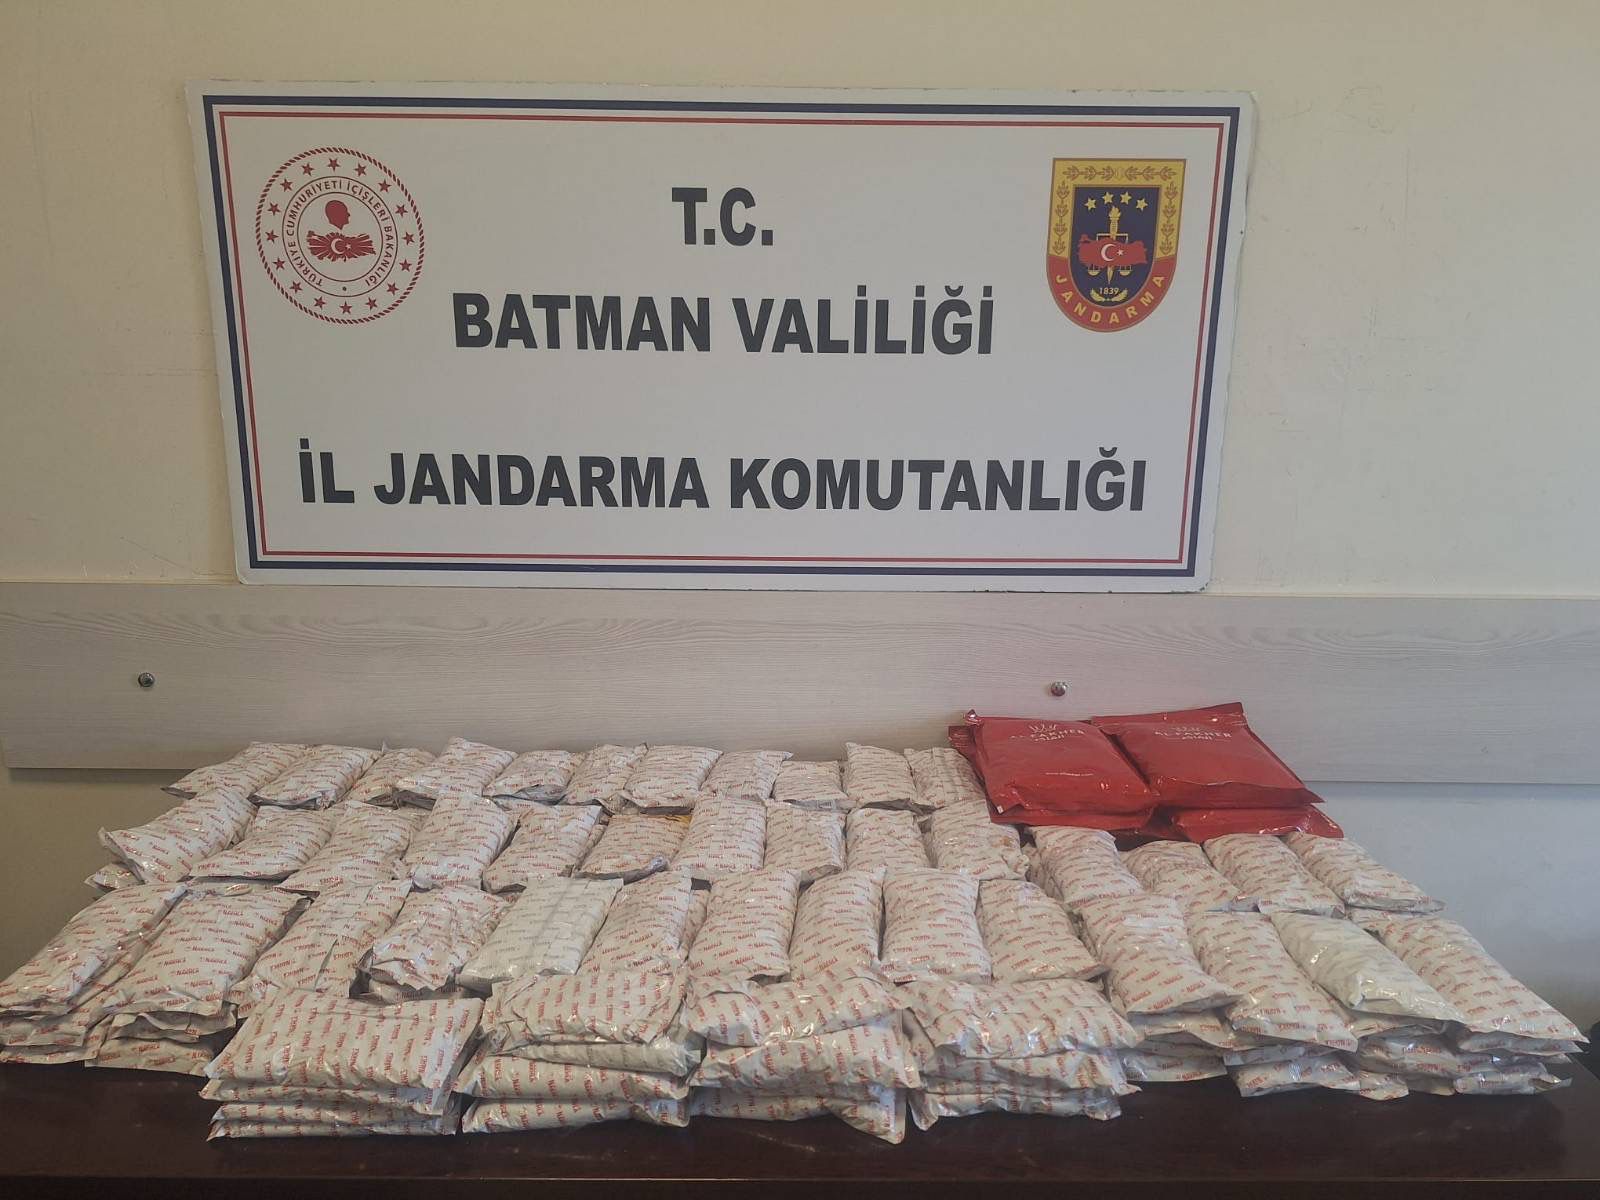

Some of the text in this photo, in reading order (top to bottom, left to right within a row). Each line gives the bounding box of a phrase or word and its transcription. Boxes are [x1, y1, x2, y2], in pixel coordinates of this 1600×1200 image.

[286, 179, 342, 236] CUMHURİYETİ
[347, 180, 391, 223] İÇİŞLERİ
[672, 187, 774, 246] T.C.
[365, 226, 394, 287] BAKANLIĞI
[453, 285, 993, 355] BATMAN VALİLİĞİ
[1055, 274, 1165, 324] JANDARMA
[1099, 287, 1120, 296] 1839
[299, 438, 1147, 512] İL JANDARMA KOMUTANLIĞI
